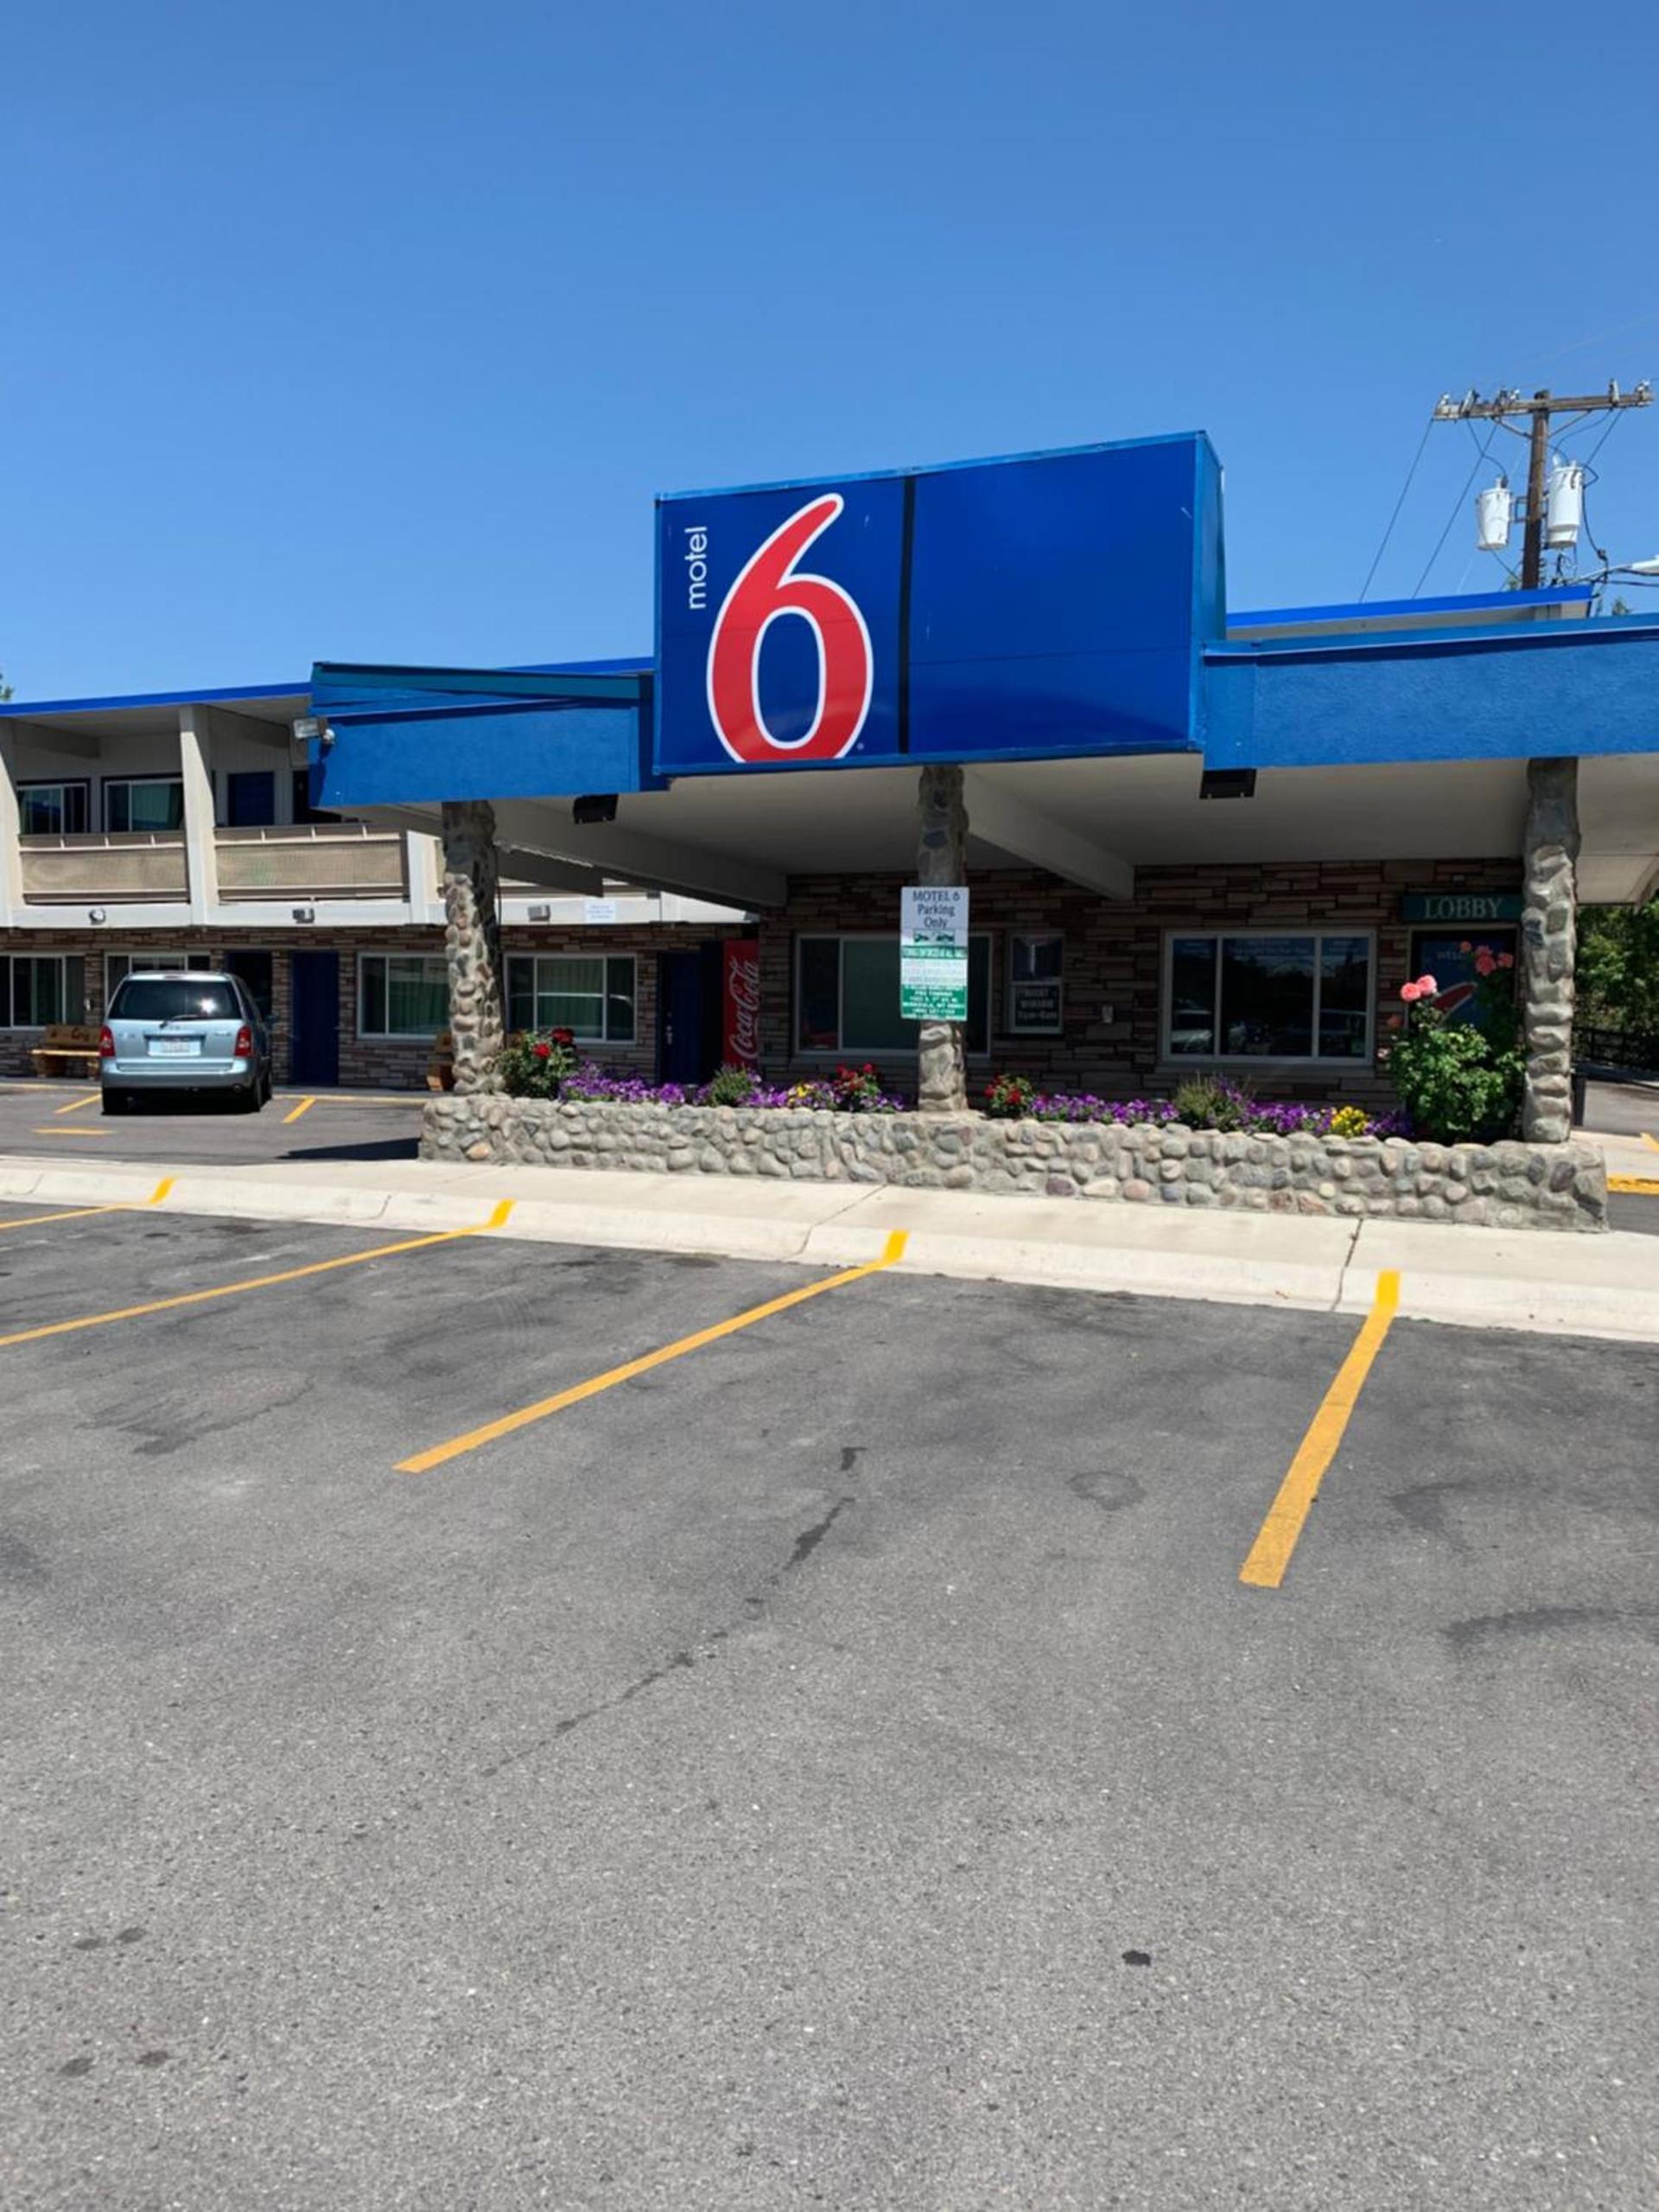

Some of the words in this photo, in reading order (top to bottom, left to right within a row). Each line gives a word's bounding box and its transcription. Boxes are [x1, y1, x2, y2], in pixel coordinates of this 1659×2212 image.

[684, 526, 708, 610] motel
[705, 492, 874, 764] 6
[912, 889, 950, 902] MOTEL
[953, 890, 961, 901] 6
[918, 903, 956, 918] Parking
[1425, 896, 1502, 919] LOBBY
[924, 917, 948, 930] Only
